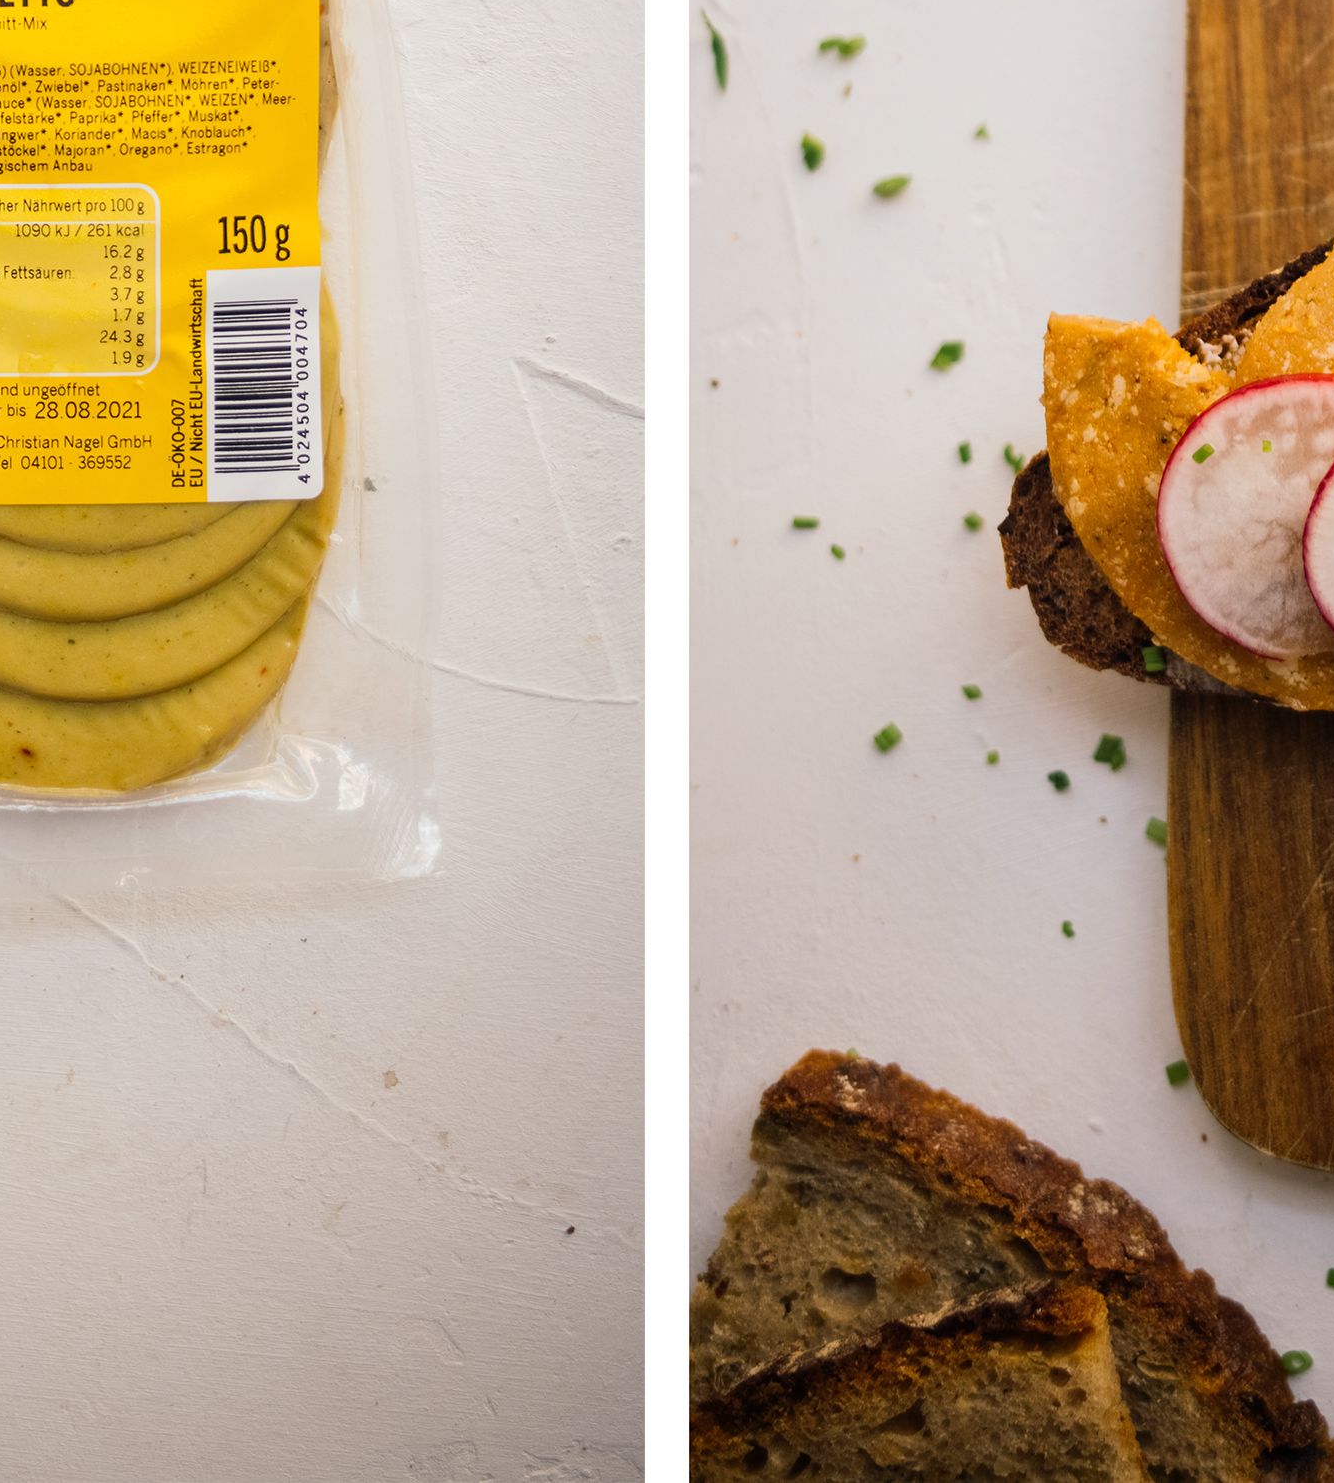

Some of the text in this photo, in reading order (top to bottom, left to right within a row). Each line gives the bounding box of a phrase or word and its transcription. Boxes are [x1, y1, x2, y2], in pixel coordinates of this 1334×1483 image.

[22, 198, 81, 212] Nährwert
[86, 201, 107, 216] pro
[110, 197, 134, 212] 100
[136, 200, 145, 215] g
[15, 223, 51, 238] 1090
[55, 223, 69, 237] kJ
[74, 223, 81, 237] /
[86, 223, 111, 237] 261
[116, 221, 144, 236] kcal
[219, 215, 291, 261] 150 g
[22, 382, 99, 399] ungeöffnet
[188, 277, 203, 487] EU / Nicht EU-Landwirtschaft
[294, 307, 311, 484] 4 024504 004704
[34, 400, 142, 419] 28.08.2021
[64, 434, 103, 452] Nagel
[107, 434, 151, 449] GmbH
[167, 399, 185, 487] DE-ÖKO-007
[20, 455, 63, 469] 04101
[77, 455, 131, 469] 369552
